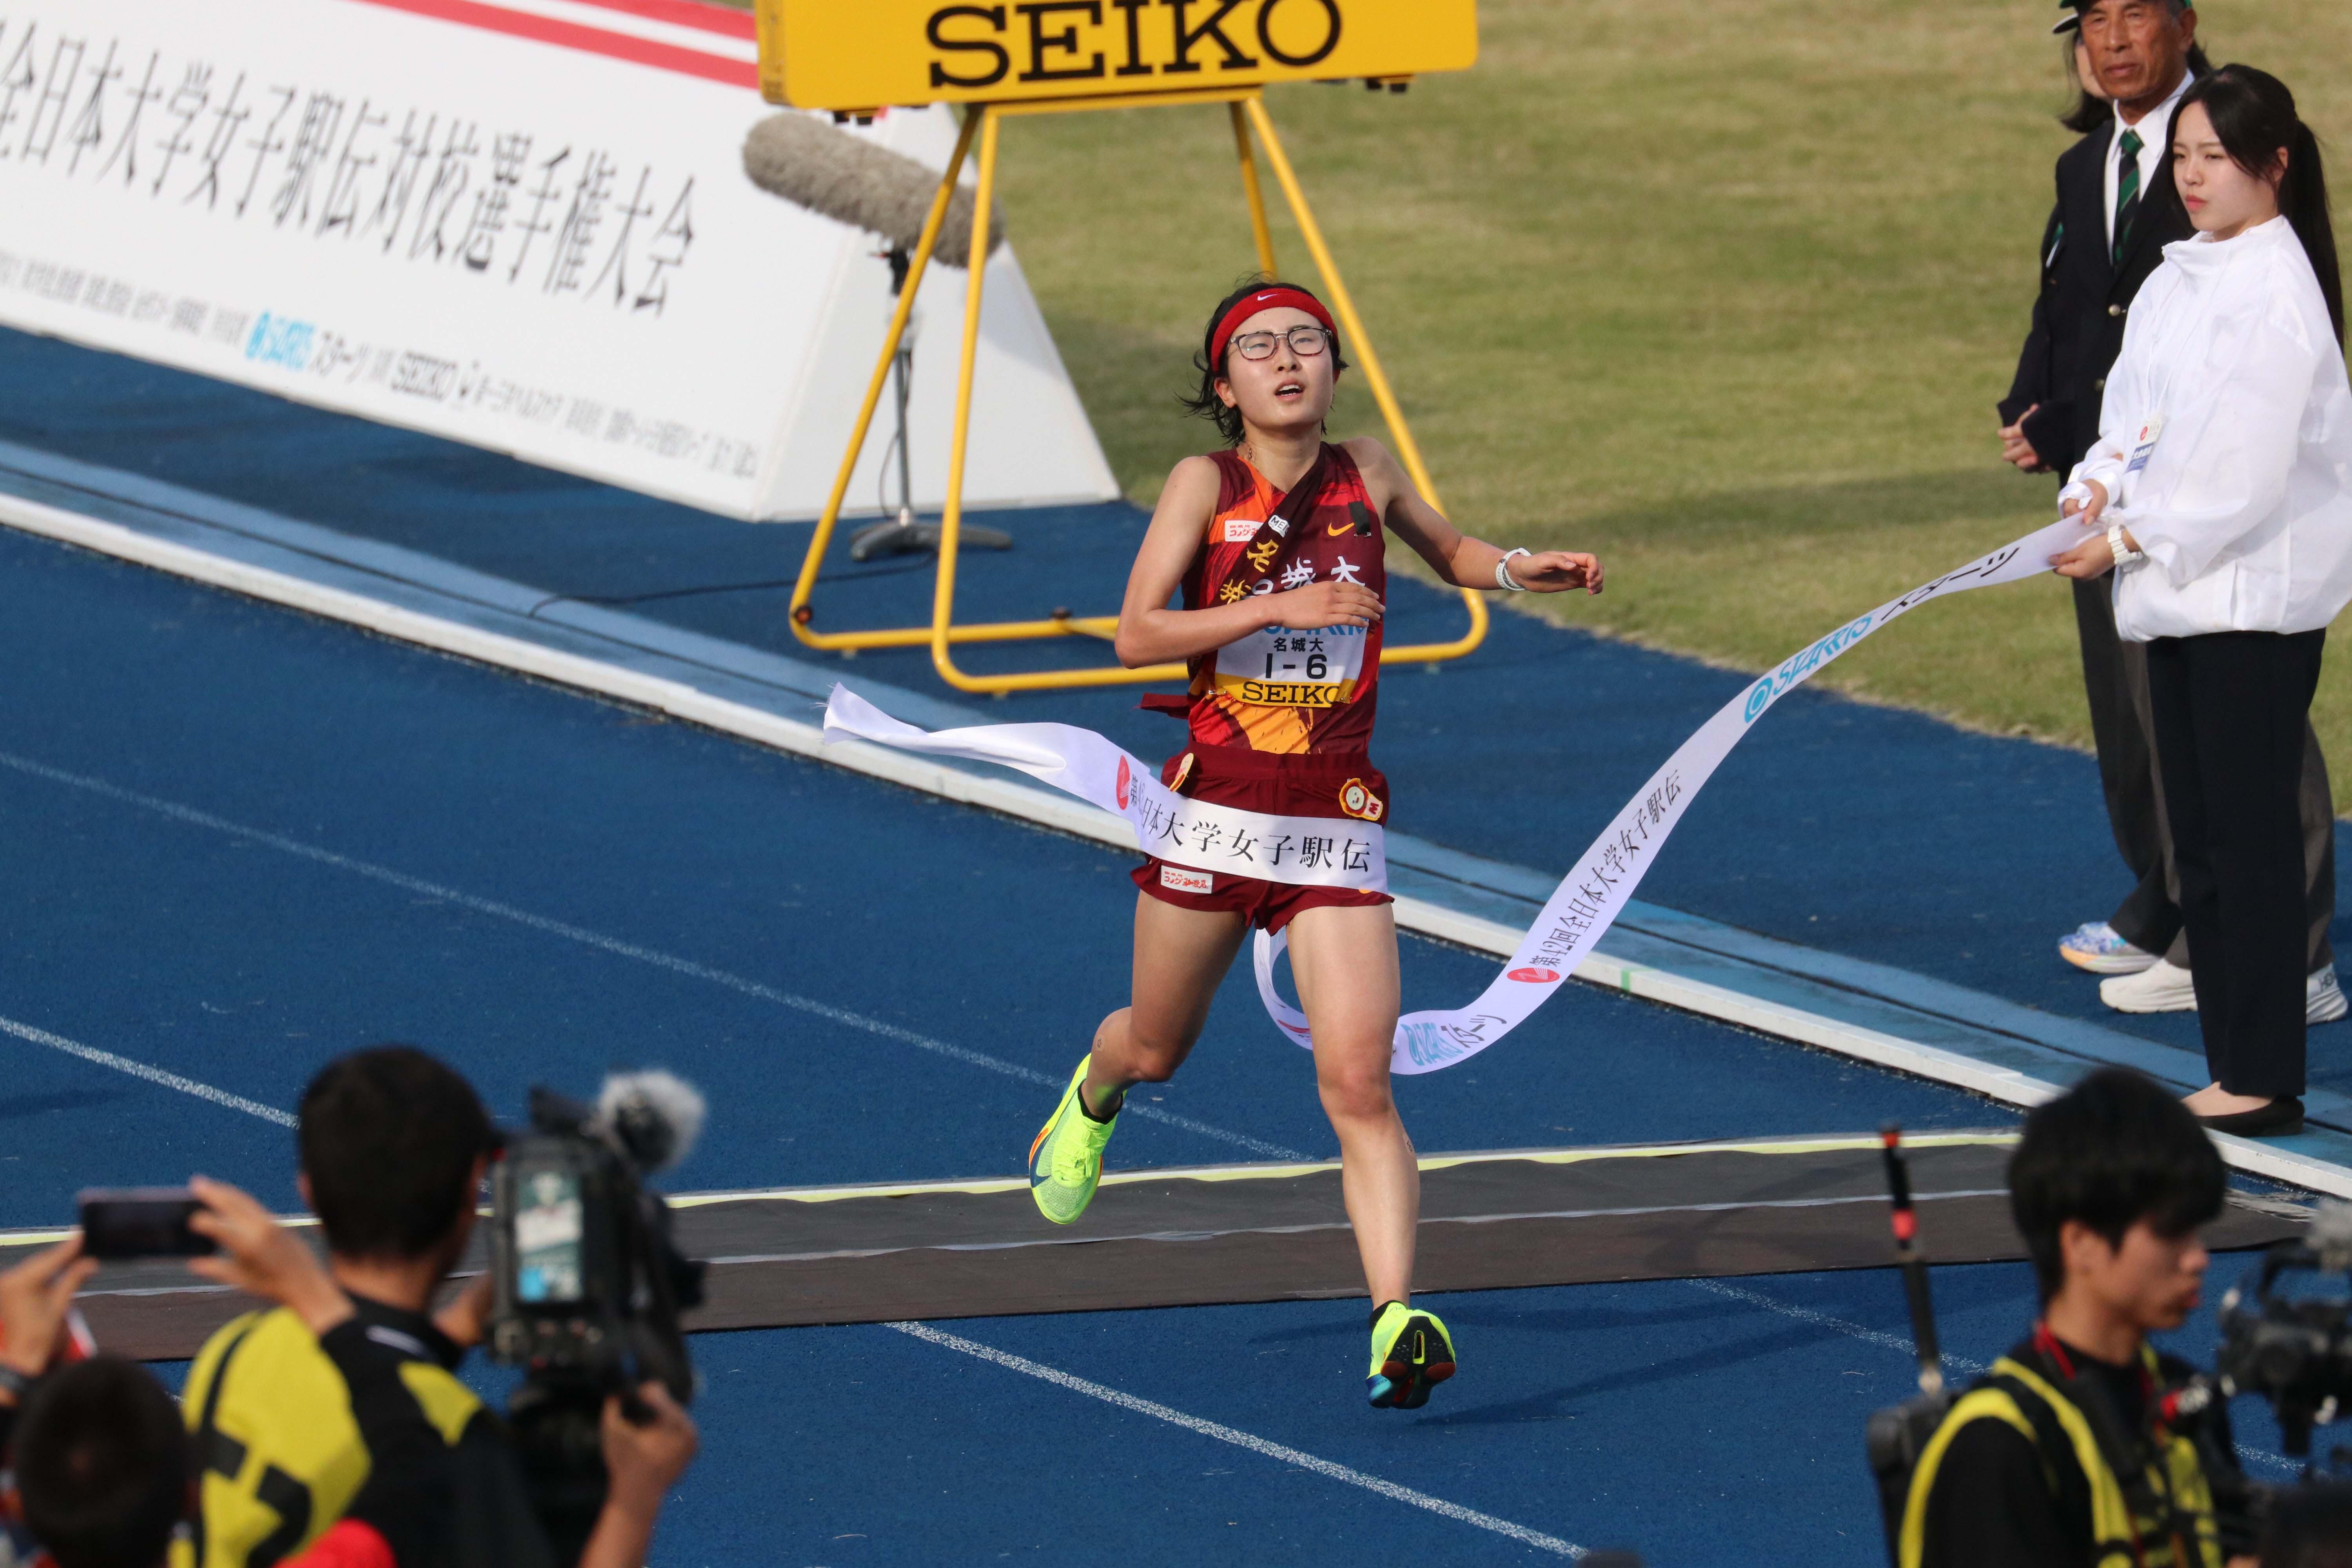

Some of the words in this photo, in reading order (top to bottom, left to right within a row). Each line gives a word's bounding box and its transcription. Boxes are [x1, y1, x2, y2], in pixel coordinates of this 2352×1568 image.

[926, 0, 1341, 87] SEIKO
[1273, 637, 1324, 652] 名城大
[1265, 653, 1327, 679] 1-6
[1242, 681, 1340, 705] SEIKO
[1529, 769, 1681, 967] 第42回全日本大学女子駅伝
